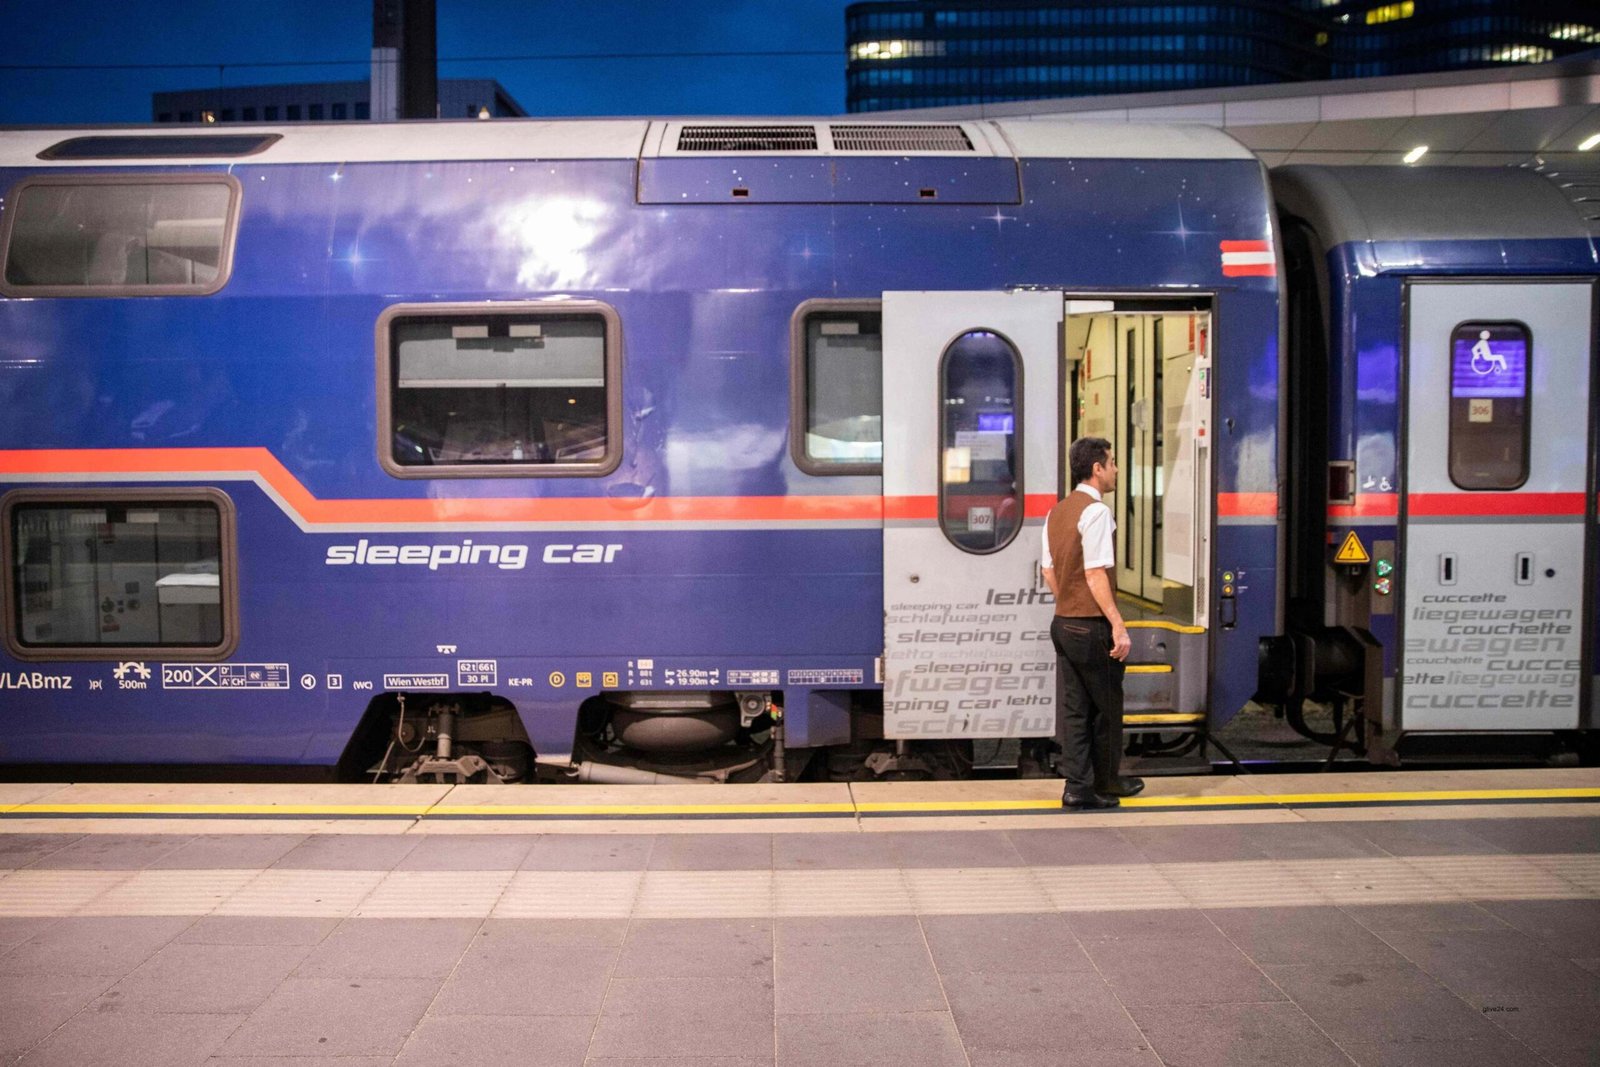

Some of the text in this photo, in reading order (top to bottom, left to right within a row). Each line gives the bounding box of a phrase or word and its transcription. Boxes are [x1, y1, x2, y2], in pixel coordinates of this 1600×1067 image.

[971, 513, 991, 526] 307
[325, 539, 623, 571] sleeping car
[1422, 593, 1507, 603] cuccette
[891, 602, 952, 612] sleeping
[886, 611, 1018, 625] schlafwagen
[1412, 607, 1572, 624] liegewagen
[1447, 622, 1572, 635] couchette
[896, 629, 1012, 646] sleeping
[1406, 656, 1484, 665] couchette
[676, 669, 708, 677] 26.90m
[913, 661, 1056, 675] sleeping car
[0, 672, 72, 689] LABmz
[164, 670, 193, 683] 200
[388, 677, 445, 686] Wien Westbf
[467, 674, 477, 683] 30
[508, 678, 533, 687] KE-PR
[678, 678, 708, 686] 19.90m
[1447, 671, 1578, 688] liegewag
[119, 679, 147, 690] 500m
[353, 680, 373, 690] (WC)
[957, 699, 1002, 709] car
[1007, 694, 1053, 706] letto
[1406, 690, 1575, 709] cuccette
[895, 709, 1055, 736] schlafw
